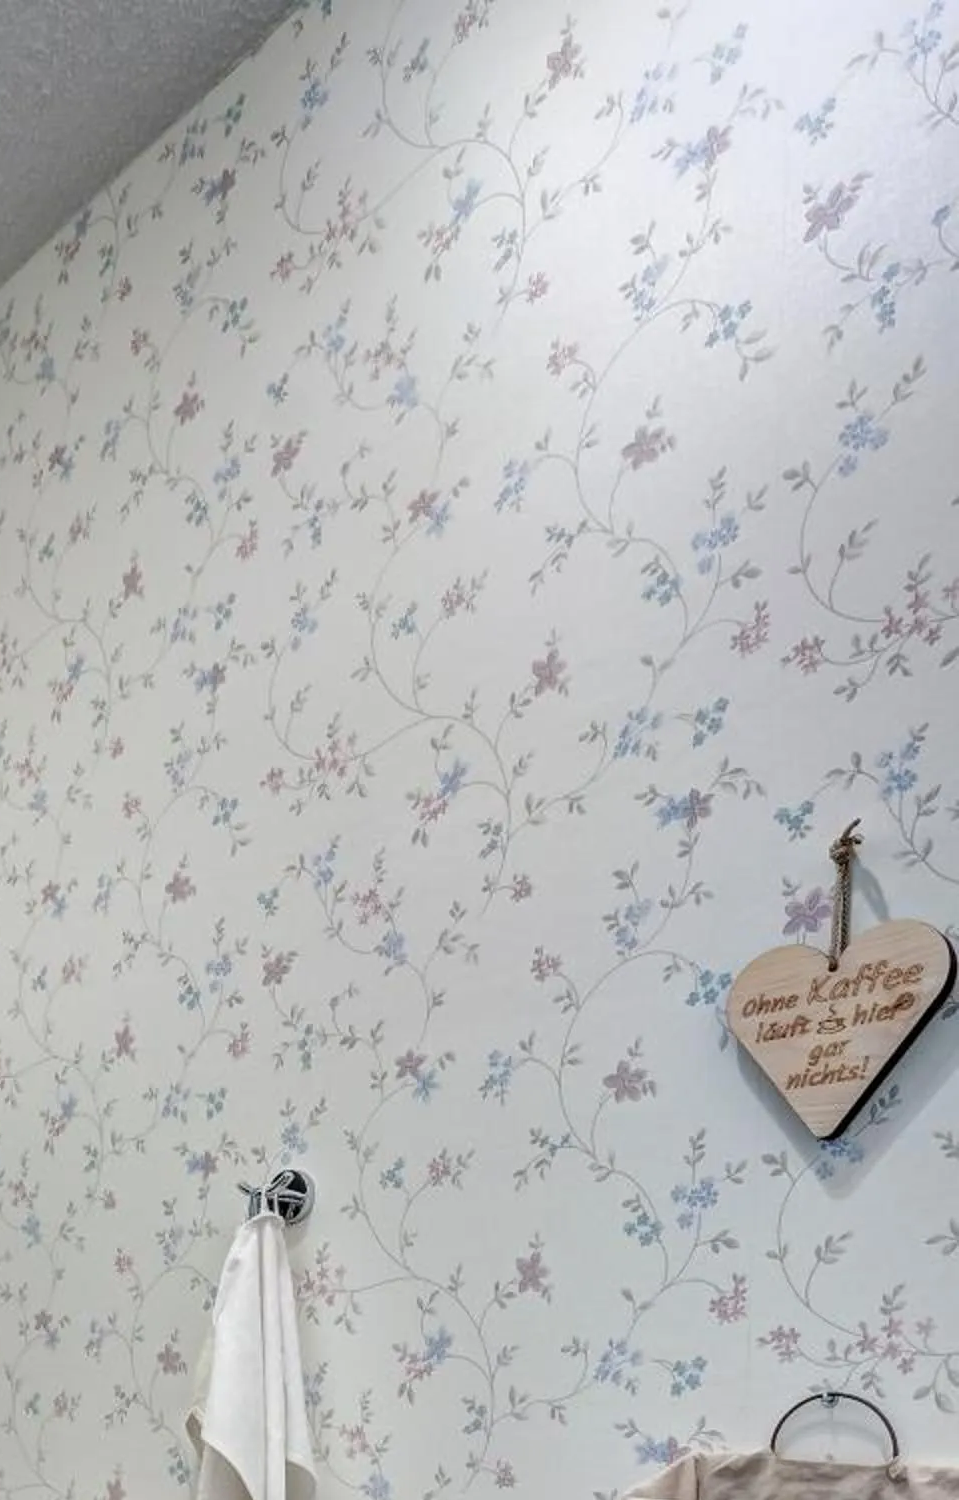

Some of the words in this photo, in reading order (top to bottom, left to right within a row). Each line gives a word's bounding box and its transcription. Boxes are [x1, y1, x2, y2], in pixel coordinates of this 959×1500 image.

[806, 959, 925, 1003] Kaffee
[808, 1039, 852, 1067] gar
[785, 1055, 870, 1090] nichts!
